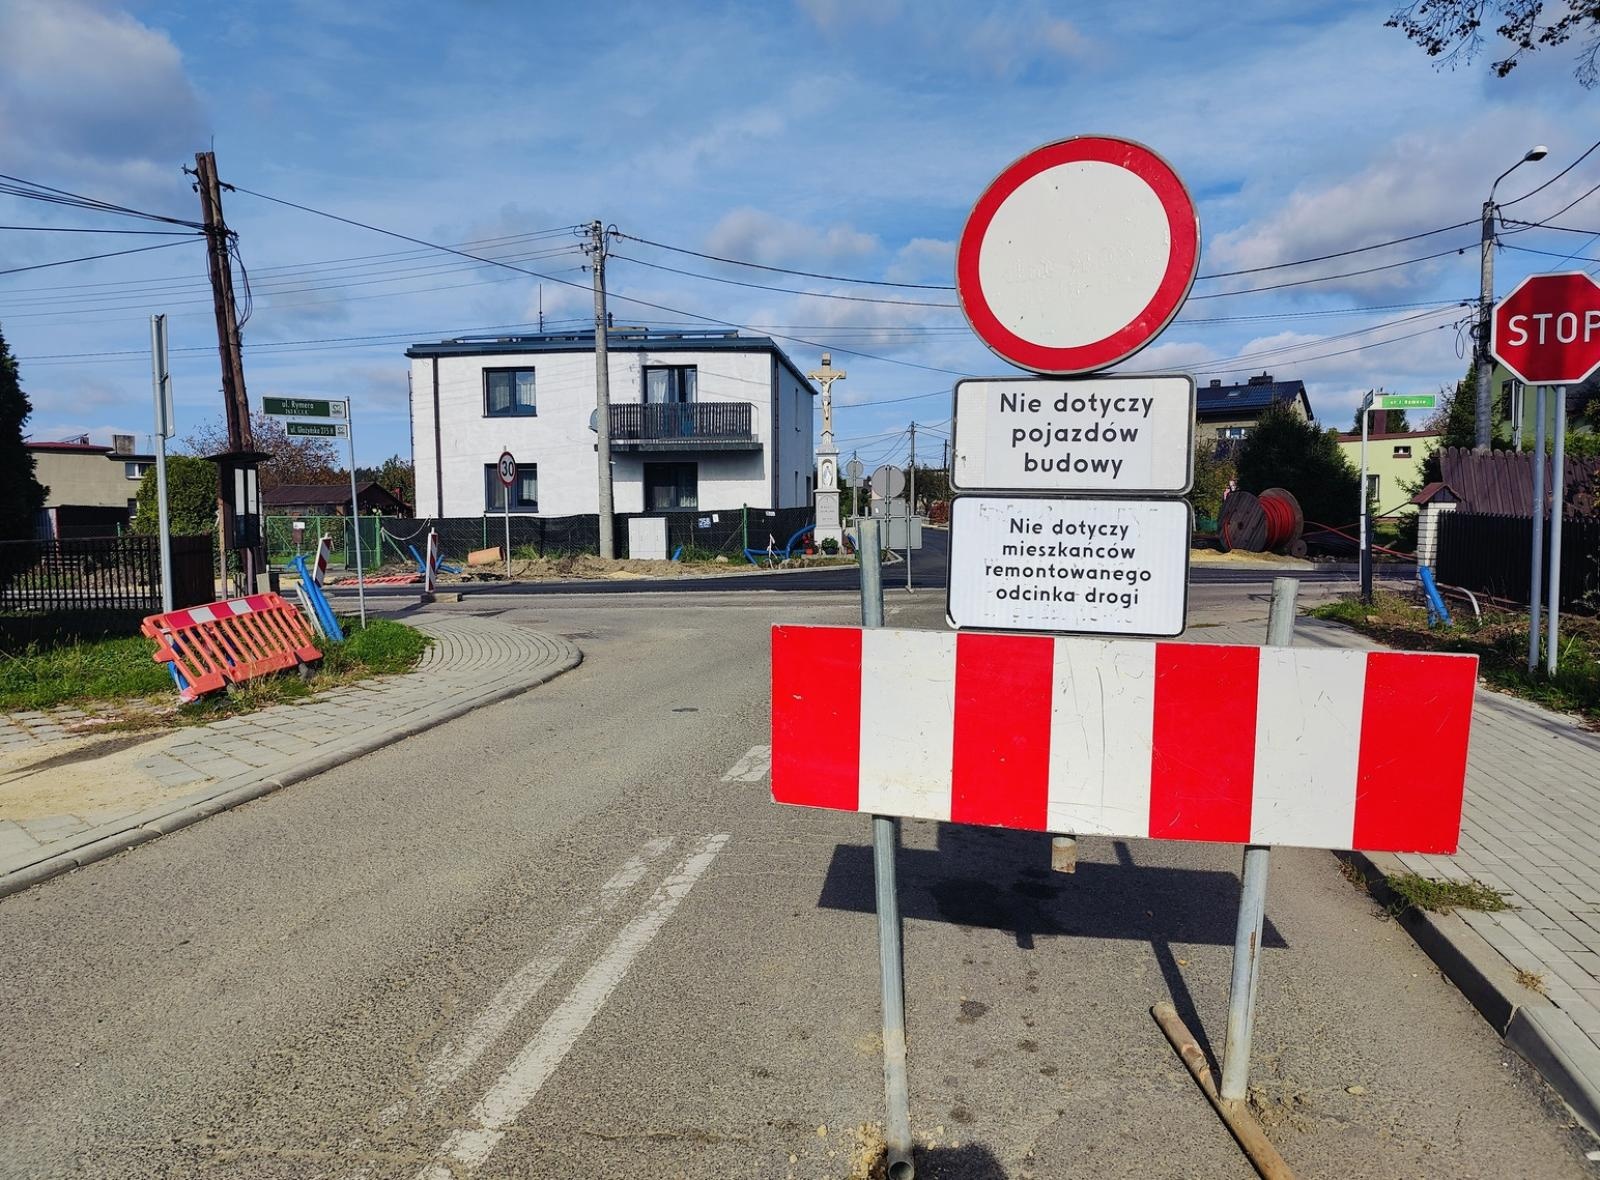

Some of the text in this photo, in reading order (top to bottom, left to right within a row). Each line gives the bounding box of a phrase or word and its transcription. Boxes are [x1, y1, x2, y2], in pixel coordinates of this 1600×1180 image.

[1507, 310, 1600, 347] STOP
[1000, 392, 1154, 418] Nie dotyczy
[1012, 422, 1139, 448] pojazdów
[501, 460, 515, 477] 30
[1024, 452, 1123, 479] budowy
[1010, 518, 1129, 541] Nie dotyczy
[1002, 541, 1136, 559] mieszkańców
[985, 563, 1151, 585] remontowanego
[996, 585, 1138, 609] odcinka drogi
